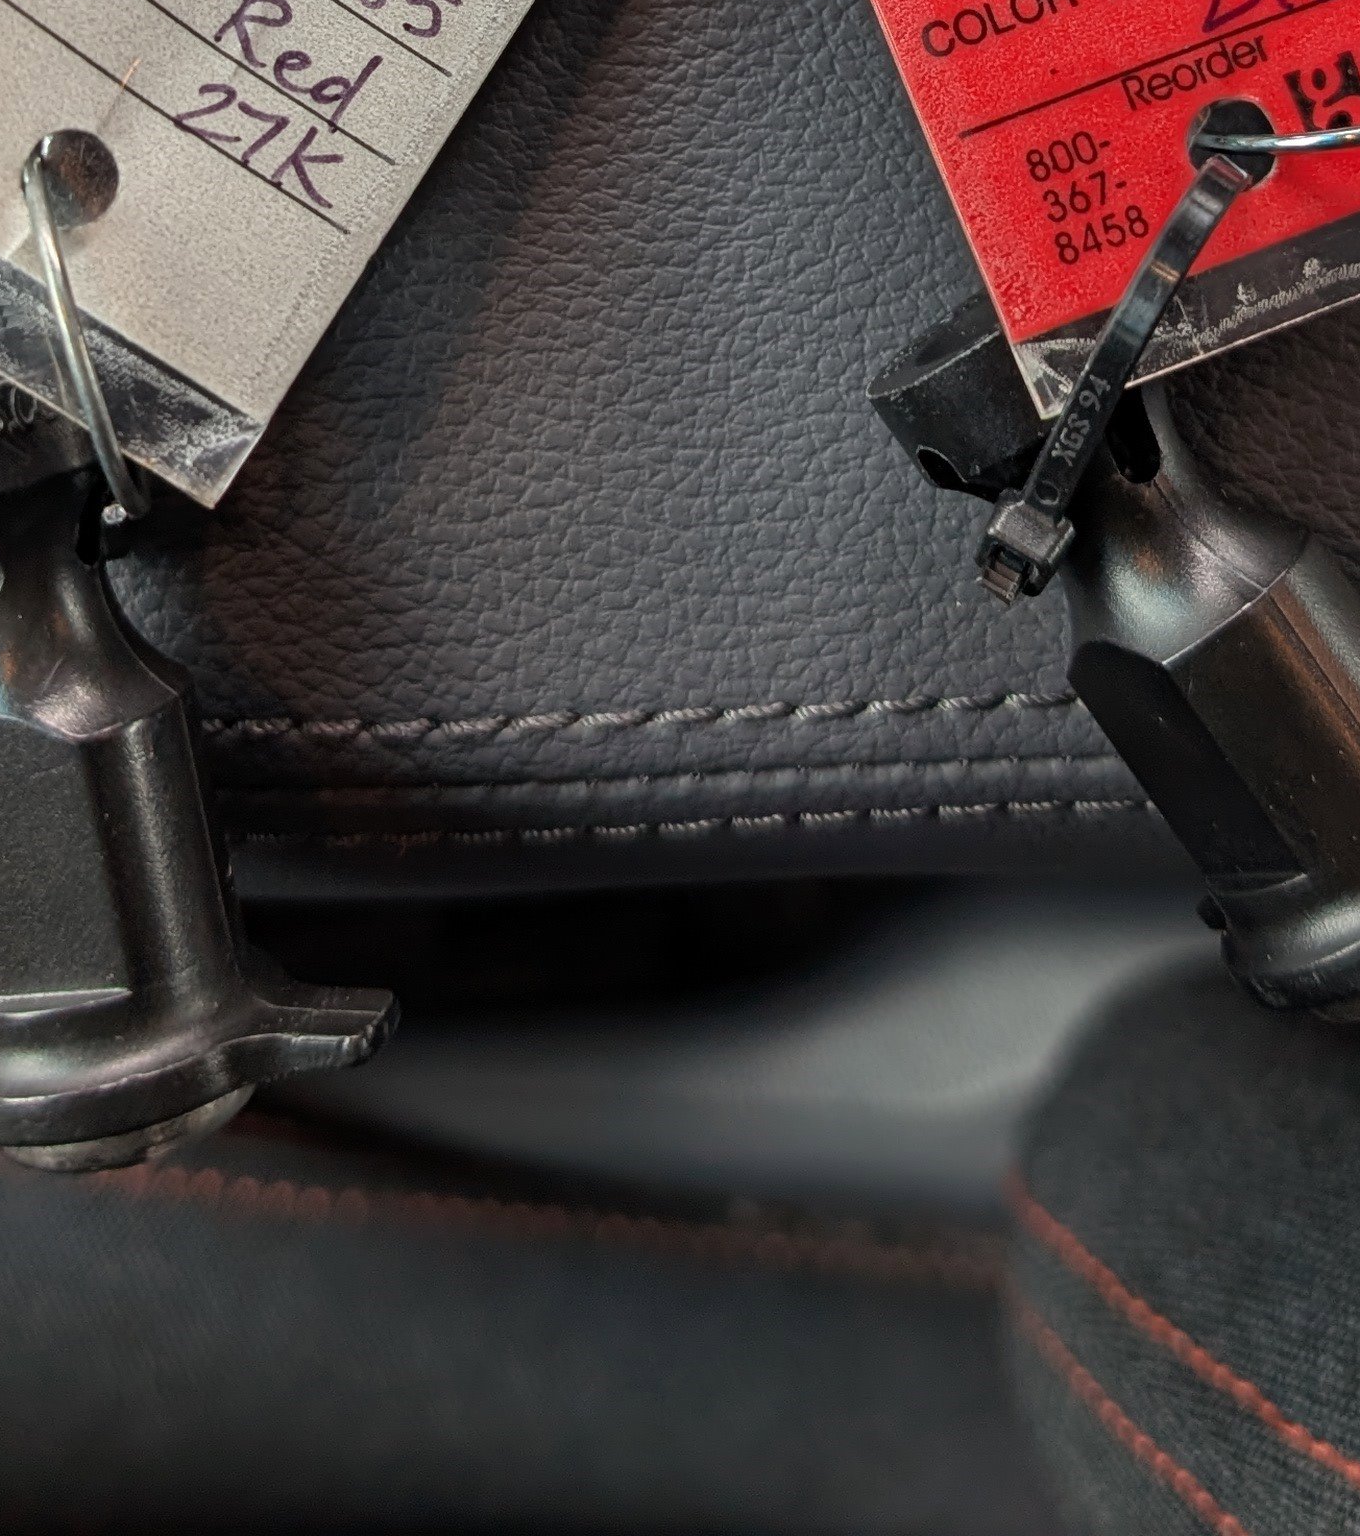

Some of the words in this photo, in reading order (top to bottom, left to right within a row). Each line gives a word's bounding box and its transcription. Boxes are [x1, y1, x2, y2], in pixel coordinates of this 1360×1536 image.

[1120, 32, 1271, 112] Reorder
[175, 82, 346, 210] 27K
[1025, 131, 1111, 183] 800-
[1041, 169, 1129, 223] 367-
[1053, 204, 1151, 266] 8458
